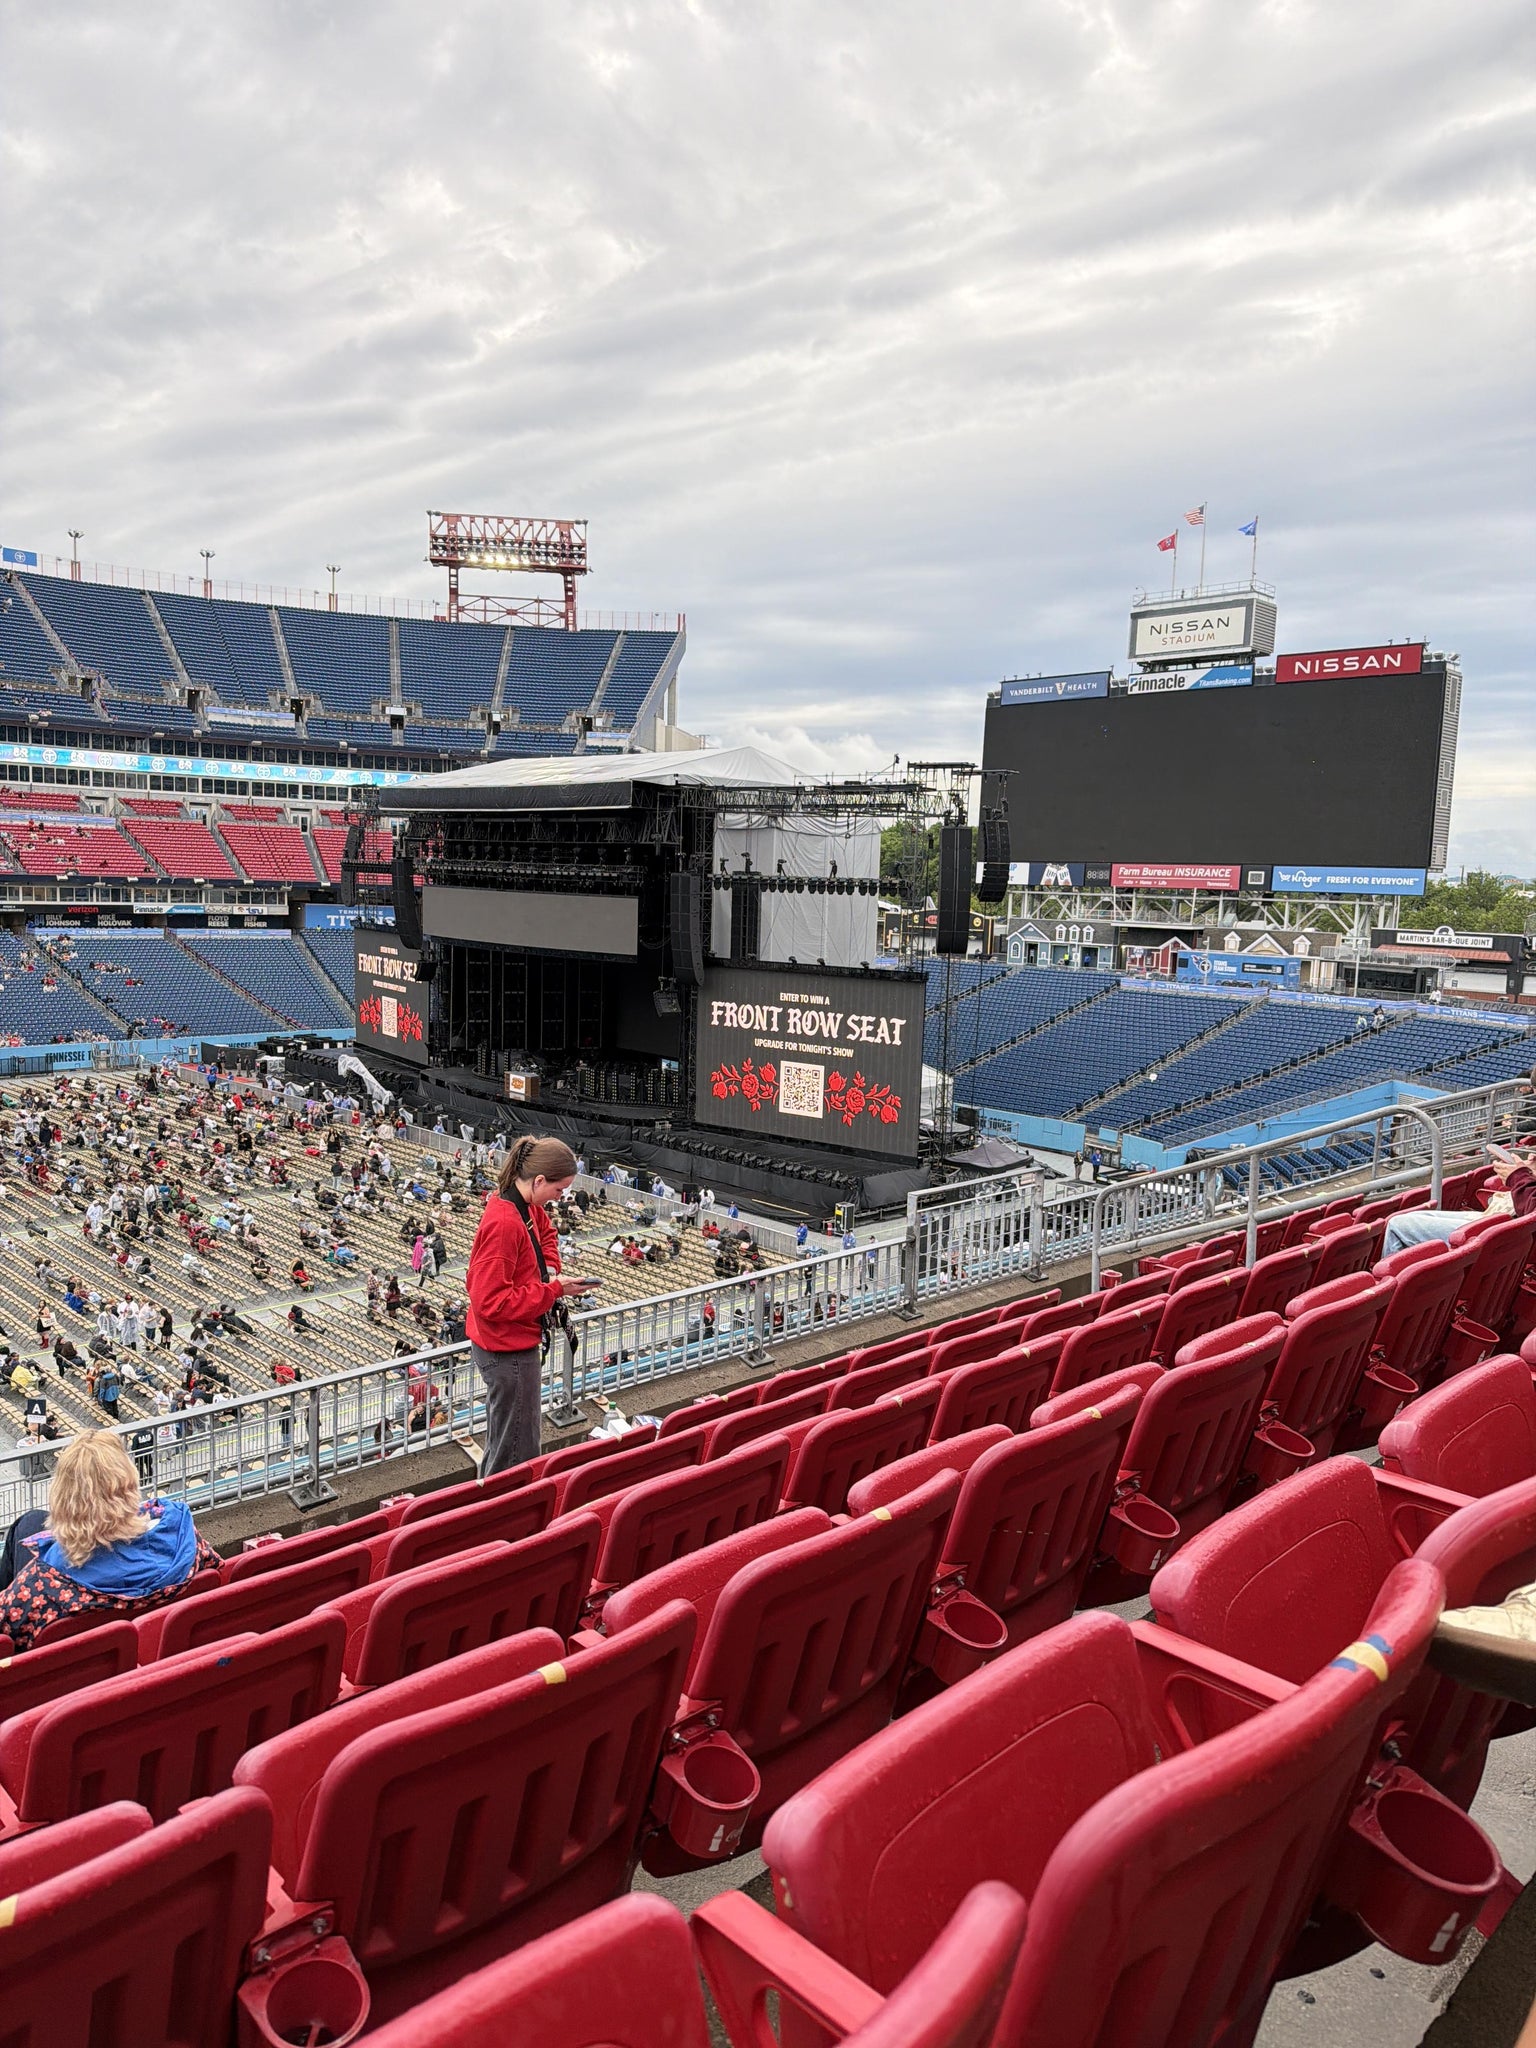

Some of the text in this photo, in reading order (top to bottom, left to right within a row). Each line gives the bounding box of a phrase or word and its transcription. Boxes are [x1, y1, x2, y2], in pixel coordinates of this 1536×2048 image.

[1149, 616, 1230, 635] NISSAN
[1161, 633, 1215, 646] STADIUM
[1294, 652, 1402, 675] NISSAN
[1009, 686, 1054, 697] VANDERBILT
[1067, 682, 1097, 692] HEALTH
[1129, 674, 1186, 692] Pinnacle
[1118, 867, 1232, 878] Farm Bureau INSURANCE
[1291, 870, 1322, 888] Kroger
[1326, 875, 1350, 884] FRESH
[1352, 876, 1370, 885] FOR
[1399, 934, 1431, 943] MARTIN'S
[1432, 936, 1469, 945] BAR-B-QUE
[358, 953, 383, 975] FRONT
[383, 957, 403, 980] ROW
[1165, 983, 1190, 991] TITANS
[779, 992, 830, 1006] ENTER TO WIN A
[1451, 1009, 1478, 1018] TITANS
[710, 1000, 907, 1046] FRONT ROW SEAT
[754, 1038, 854, 1058] UPGRADE FOR TONIGHT'S SHOW
[45, 1051, 85, 1063] TENNESSEE
[32, 1403, 42, 1414] A
